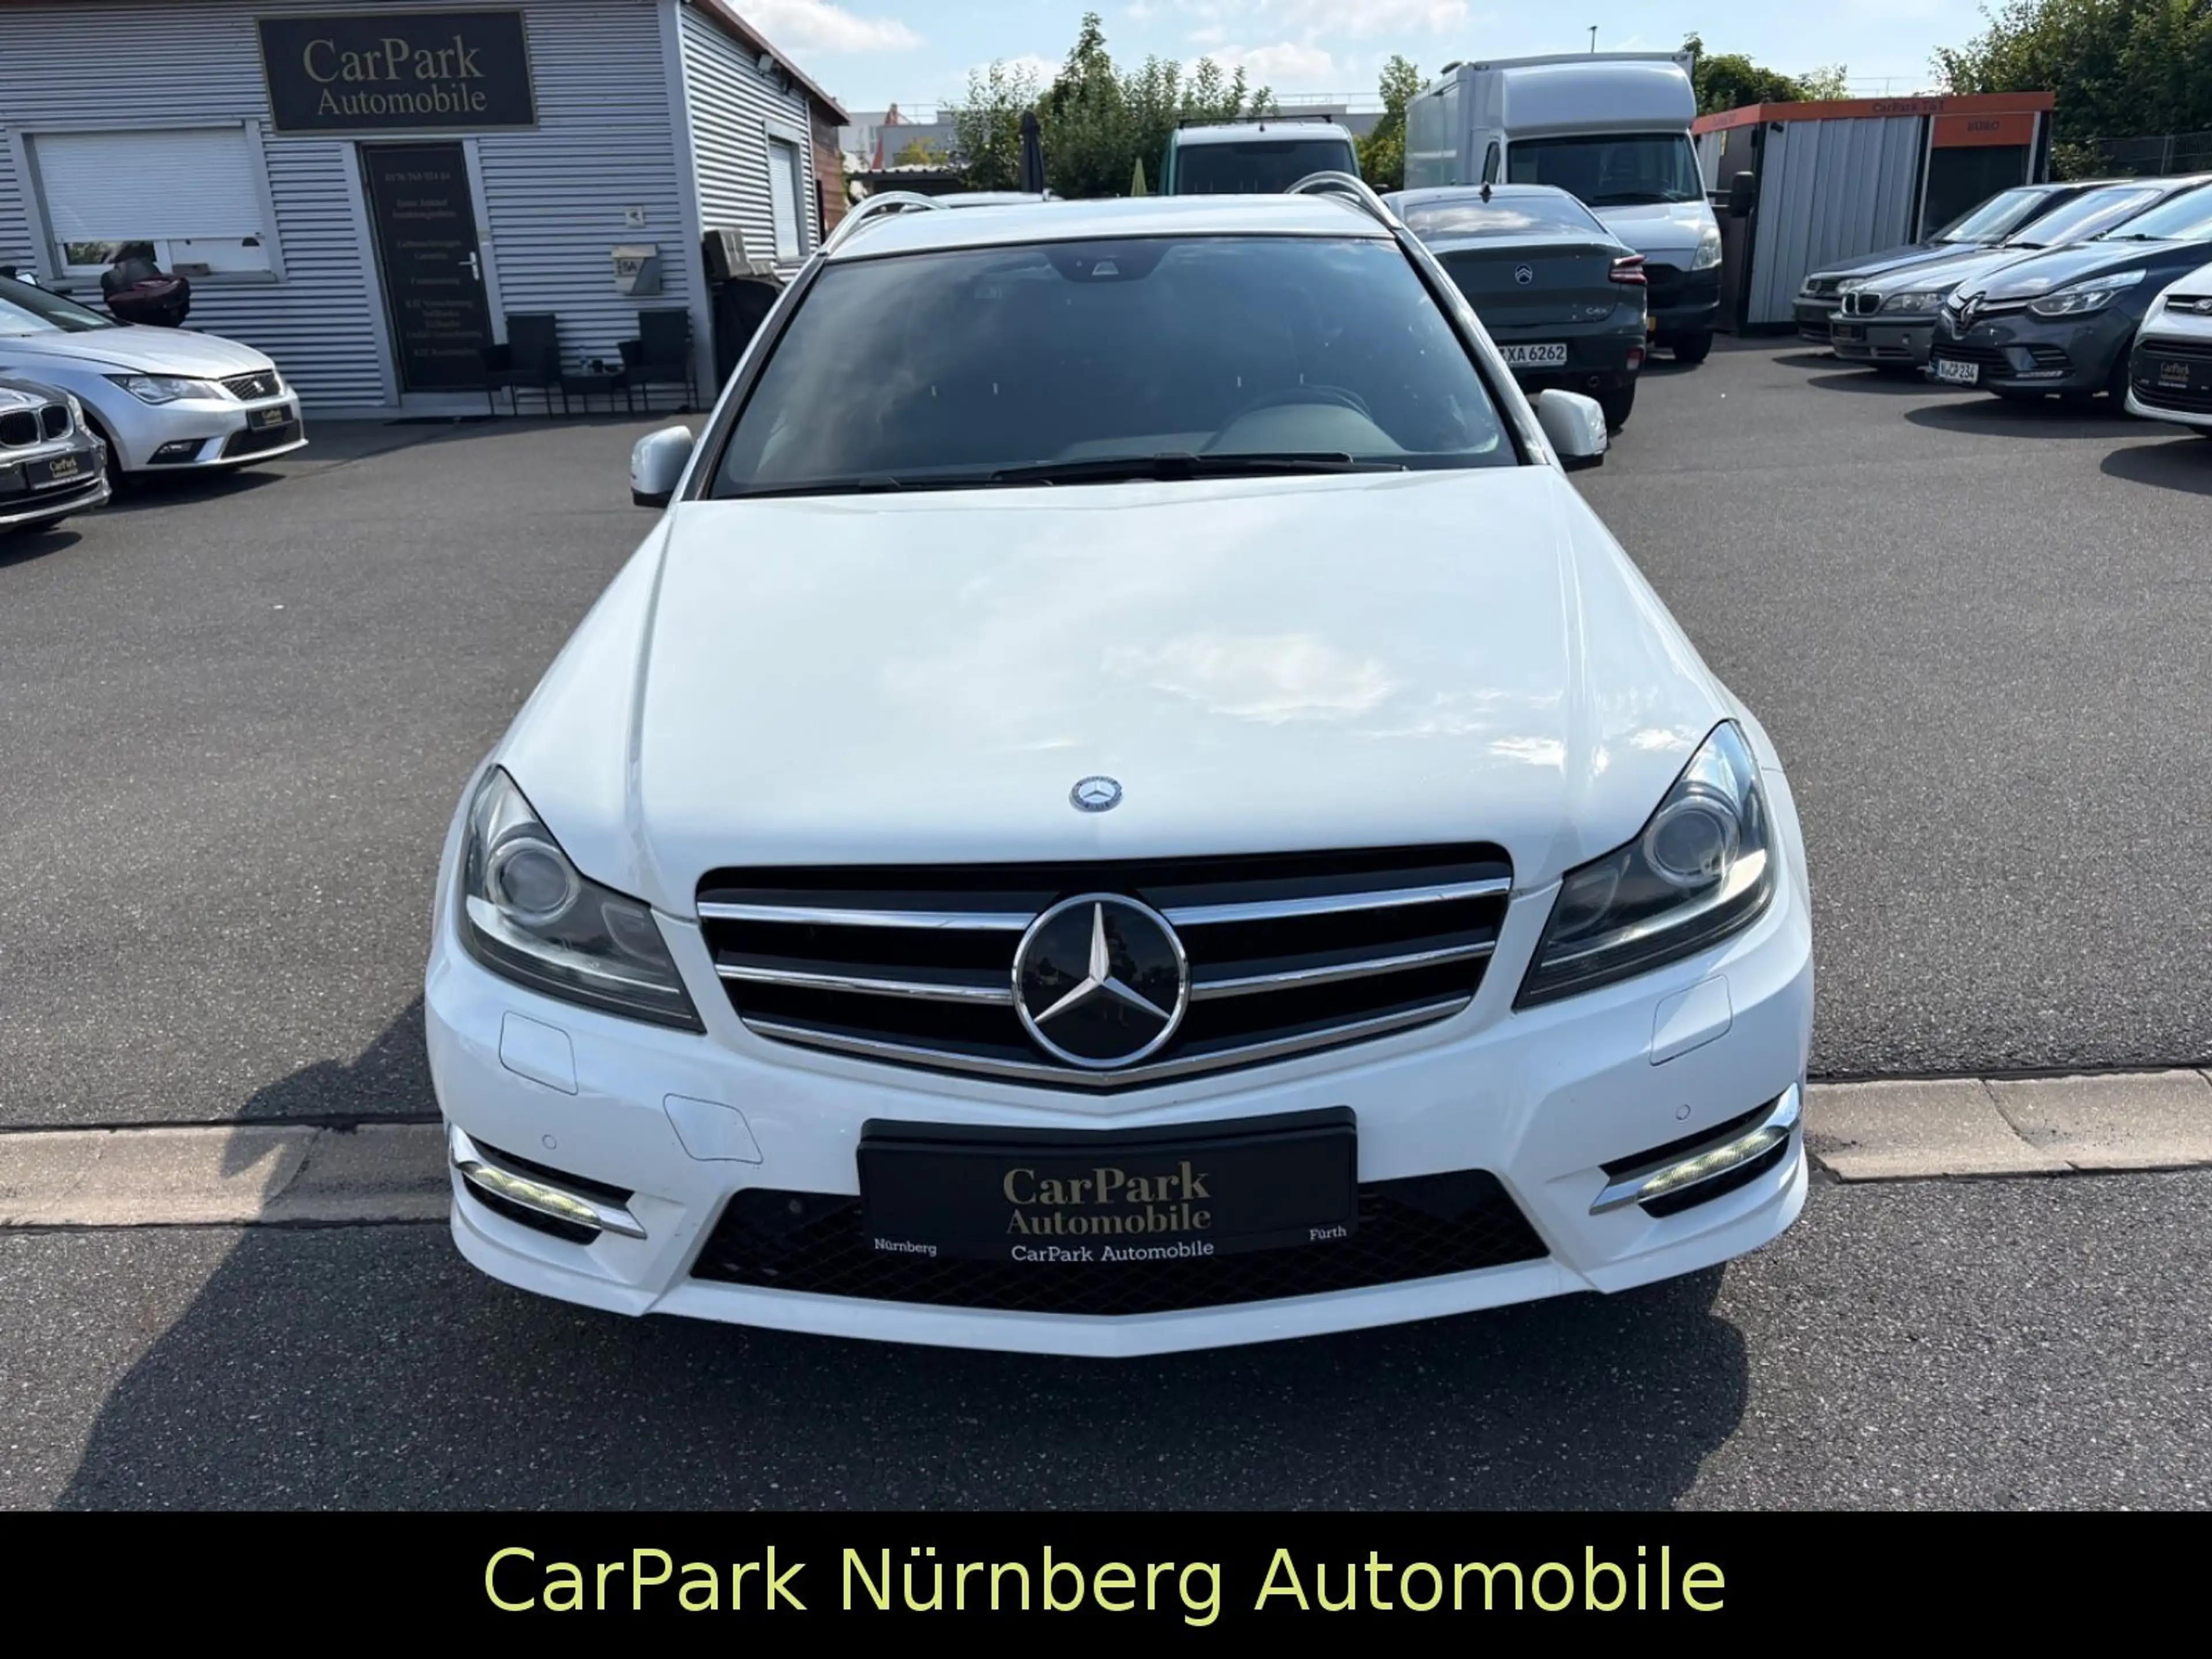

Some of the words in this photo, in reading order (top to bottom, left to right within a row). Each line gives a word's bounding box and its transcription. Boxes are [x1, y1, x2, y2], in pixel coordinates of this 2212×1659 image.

[303, 35, 486, 84] CarPark
[317, 83, 488, 115] Automobile
[1529, 345, 1565, 361] 6262
[1003, 1161, 1211, 1205] CarPark
[1006, 1204, 1211, 1236] Automobile
[874, 1237, 937, 1257] Nürnberg
[1012, 1245, 1094, 1263] CarPark
[1101, 1240, 1214, 1262] Automobile
